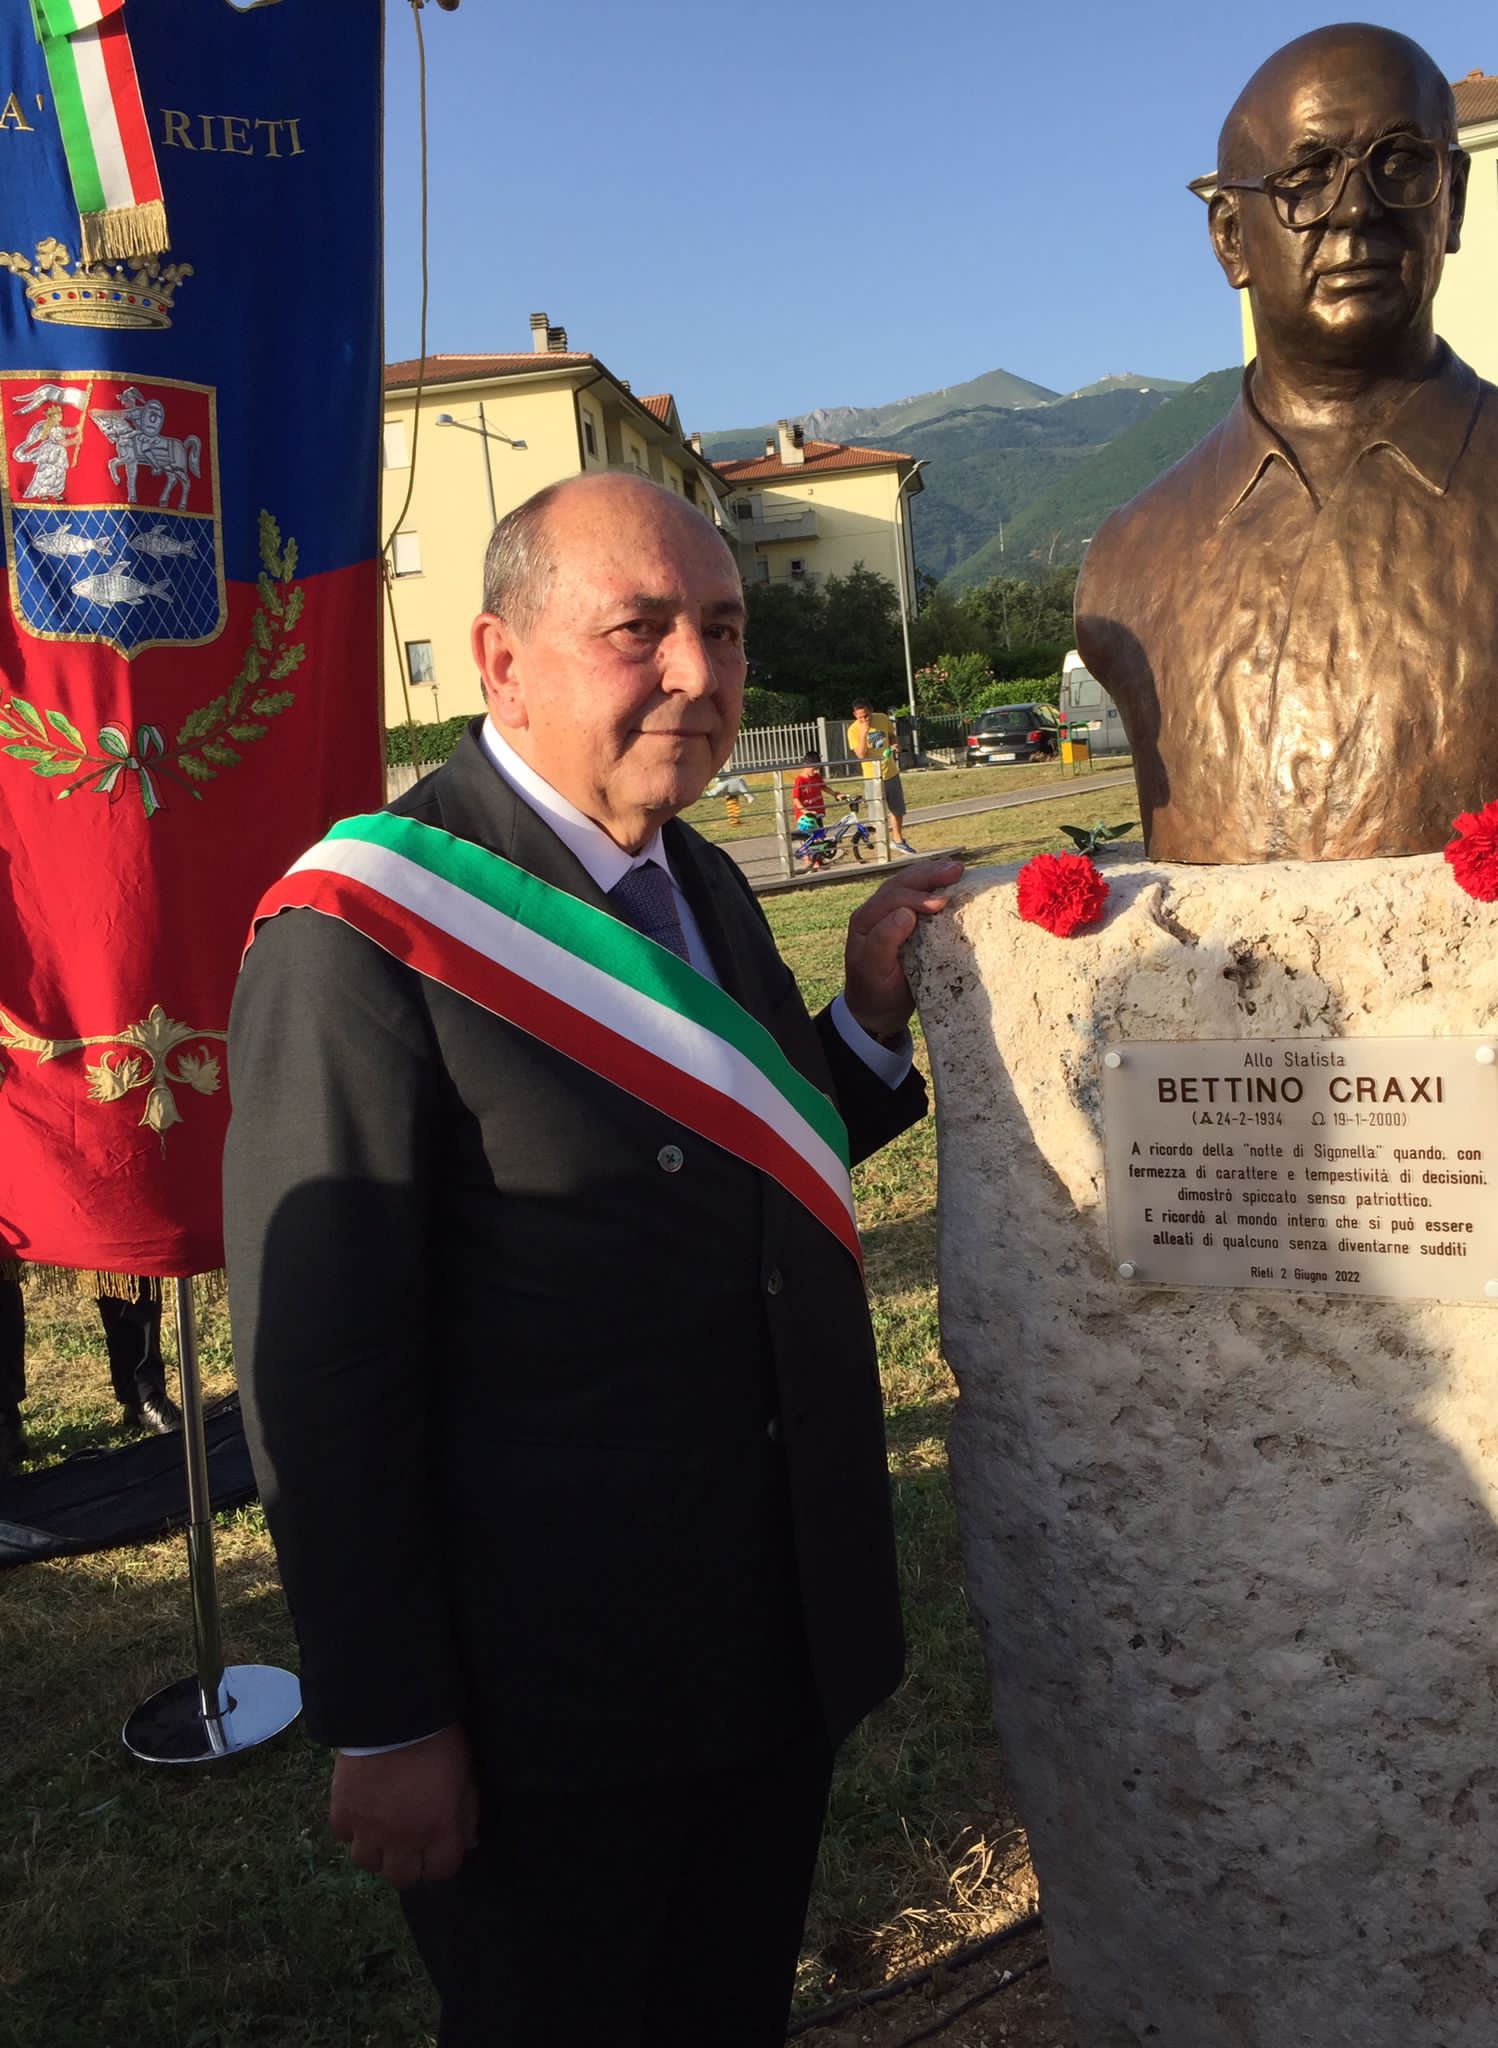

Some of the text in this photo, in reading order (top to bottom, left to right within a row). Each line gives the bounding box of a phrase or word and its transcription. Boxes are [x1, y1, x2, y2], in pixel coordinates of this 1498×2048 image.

[160, 109, 305, 158] RIETI
[1244, 1051, 1346, 1067] Allo Statista
[1158, 1077, 1442, 1103] BETTINO CRAXI
[1132, 1141, 1141, 1155] A
[1150, 1142, 1192, 1156] ricordo
[1203, 1143, 1234, 1156] della
[1244, 1144, 1283, 1157] "notte
[1293, 1144, 1304, 1157] di
[1314, 1144, 1382, 1162] Sigonella"
[1457, 1150, 1481, 1160] con
[1129, 1164, 1186, 1178] fermezza
[1196, 1165, 1206, 1179] di
[1216, 1166, 1277, 1180] carattere
[1288, 1171, 1296, 1180] e
[1400, 1169, 1411, 1183] di
[1242, 1189, 1296, 1206] spiccato
[1307, 1194, 1346, 1205] senso
[1356, 1192, 1432, 1208] patriottico.
[1145, 1208, 1153, 1222] E
[1216, 1211, 1227, 1224] al
[1237, 1212, 1277, 1226] mondo
[1288, 1213, 1327, 1228] intero
[1336, 1215, 1358, 1229] che
[1369, 1216, 1380, 1229] si
[1425, 1221, 1472, 1233] essere
[1153, 1231, 1466, 1256] alleati di qualcuno senza diventarne sudditi
[1251, 1266, 1360, 1283] Rieti 2 Giugno 2022
